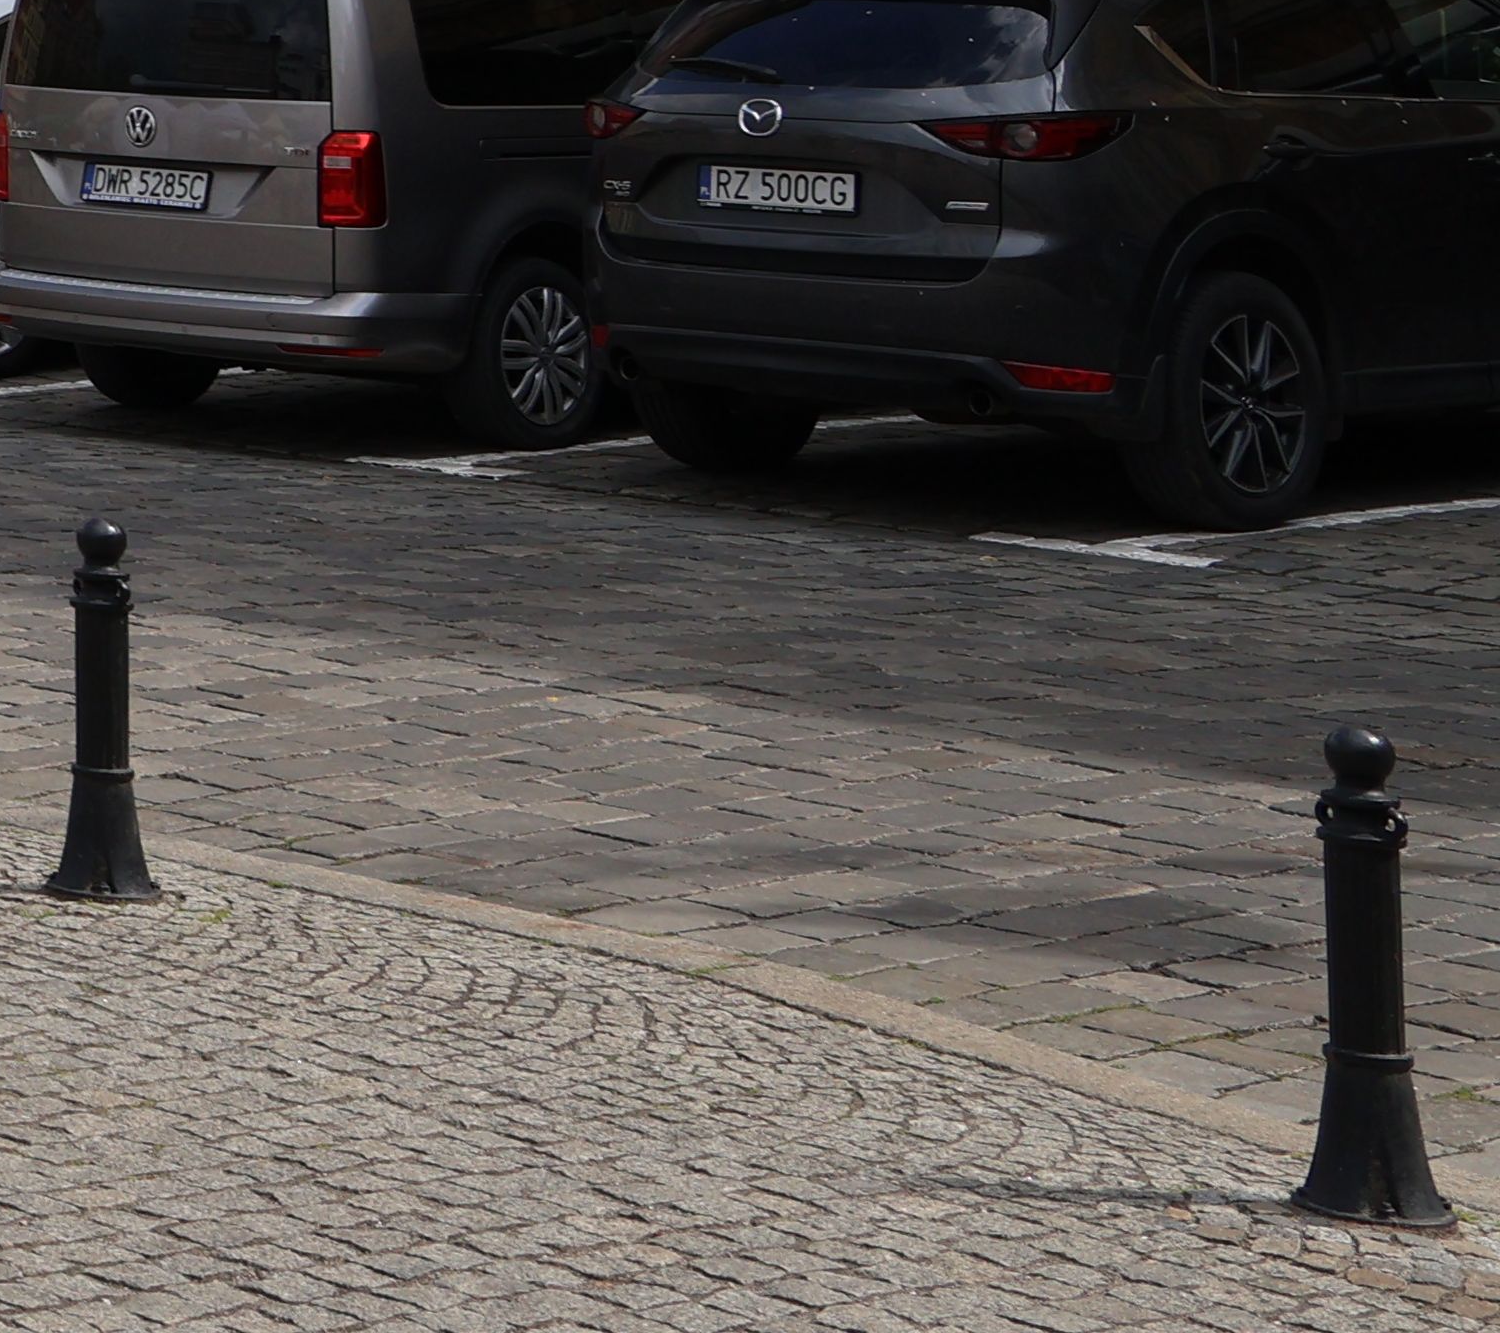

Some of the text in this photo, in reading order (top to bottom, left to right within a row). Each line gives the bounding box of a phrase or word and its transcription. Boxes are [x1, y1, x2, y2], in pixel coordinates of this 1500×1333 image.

[94, 166, 130, 194] DWR
[138, 170, 204, 201] 5285C
[716, 168, 751, 200] RZ
[761, 171, 847, 206] 500CG
